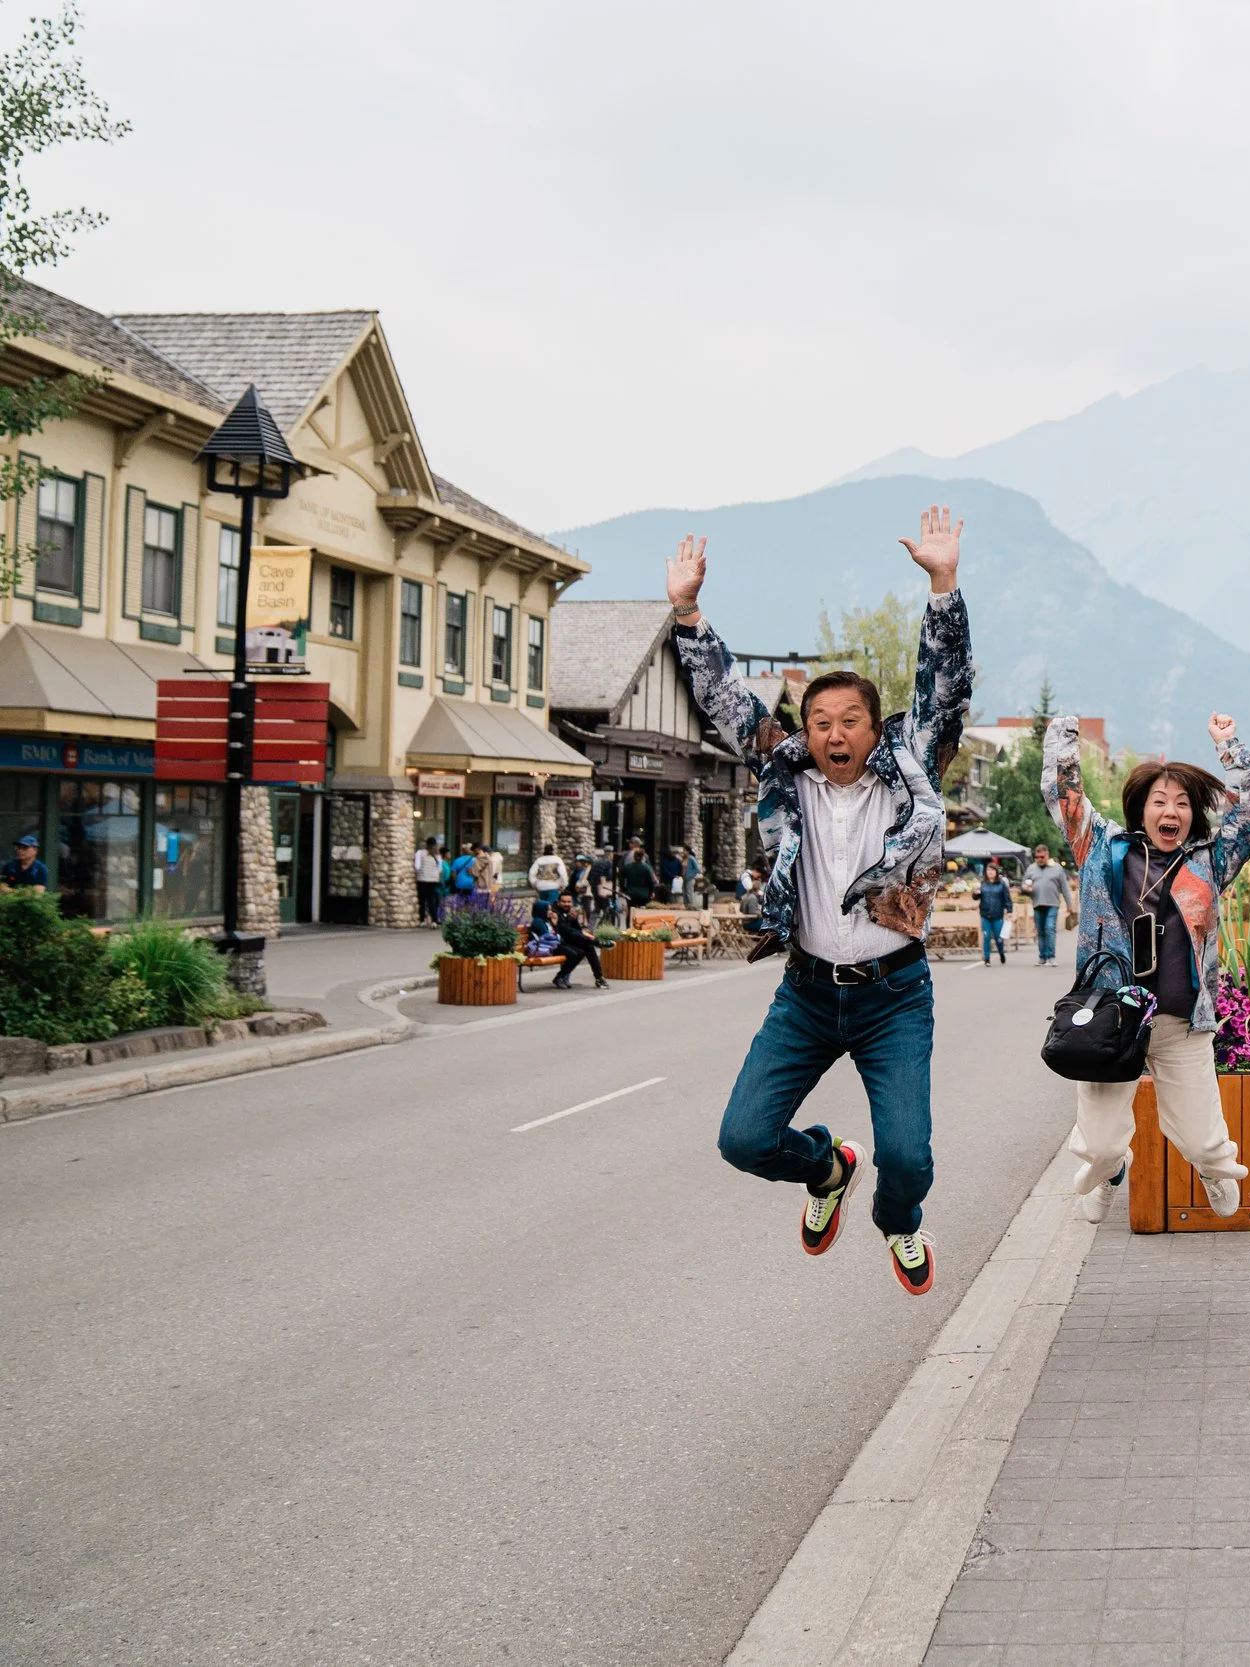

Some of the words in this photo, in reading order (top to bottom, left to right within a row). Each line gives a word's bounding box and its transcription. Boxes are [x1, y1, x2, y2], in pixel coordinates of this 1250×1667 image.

[259, 565, 295, 578] Cave
[258, 580, 285, 592] and
[257, 594, 295, 608] Basin
[21, 744, 57, 761] BMO
[83, 749, 116, 765] Bank
[117, 752, 129, 766] of
